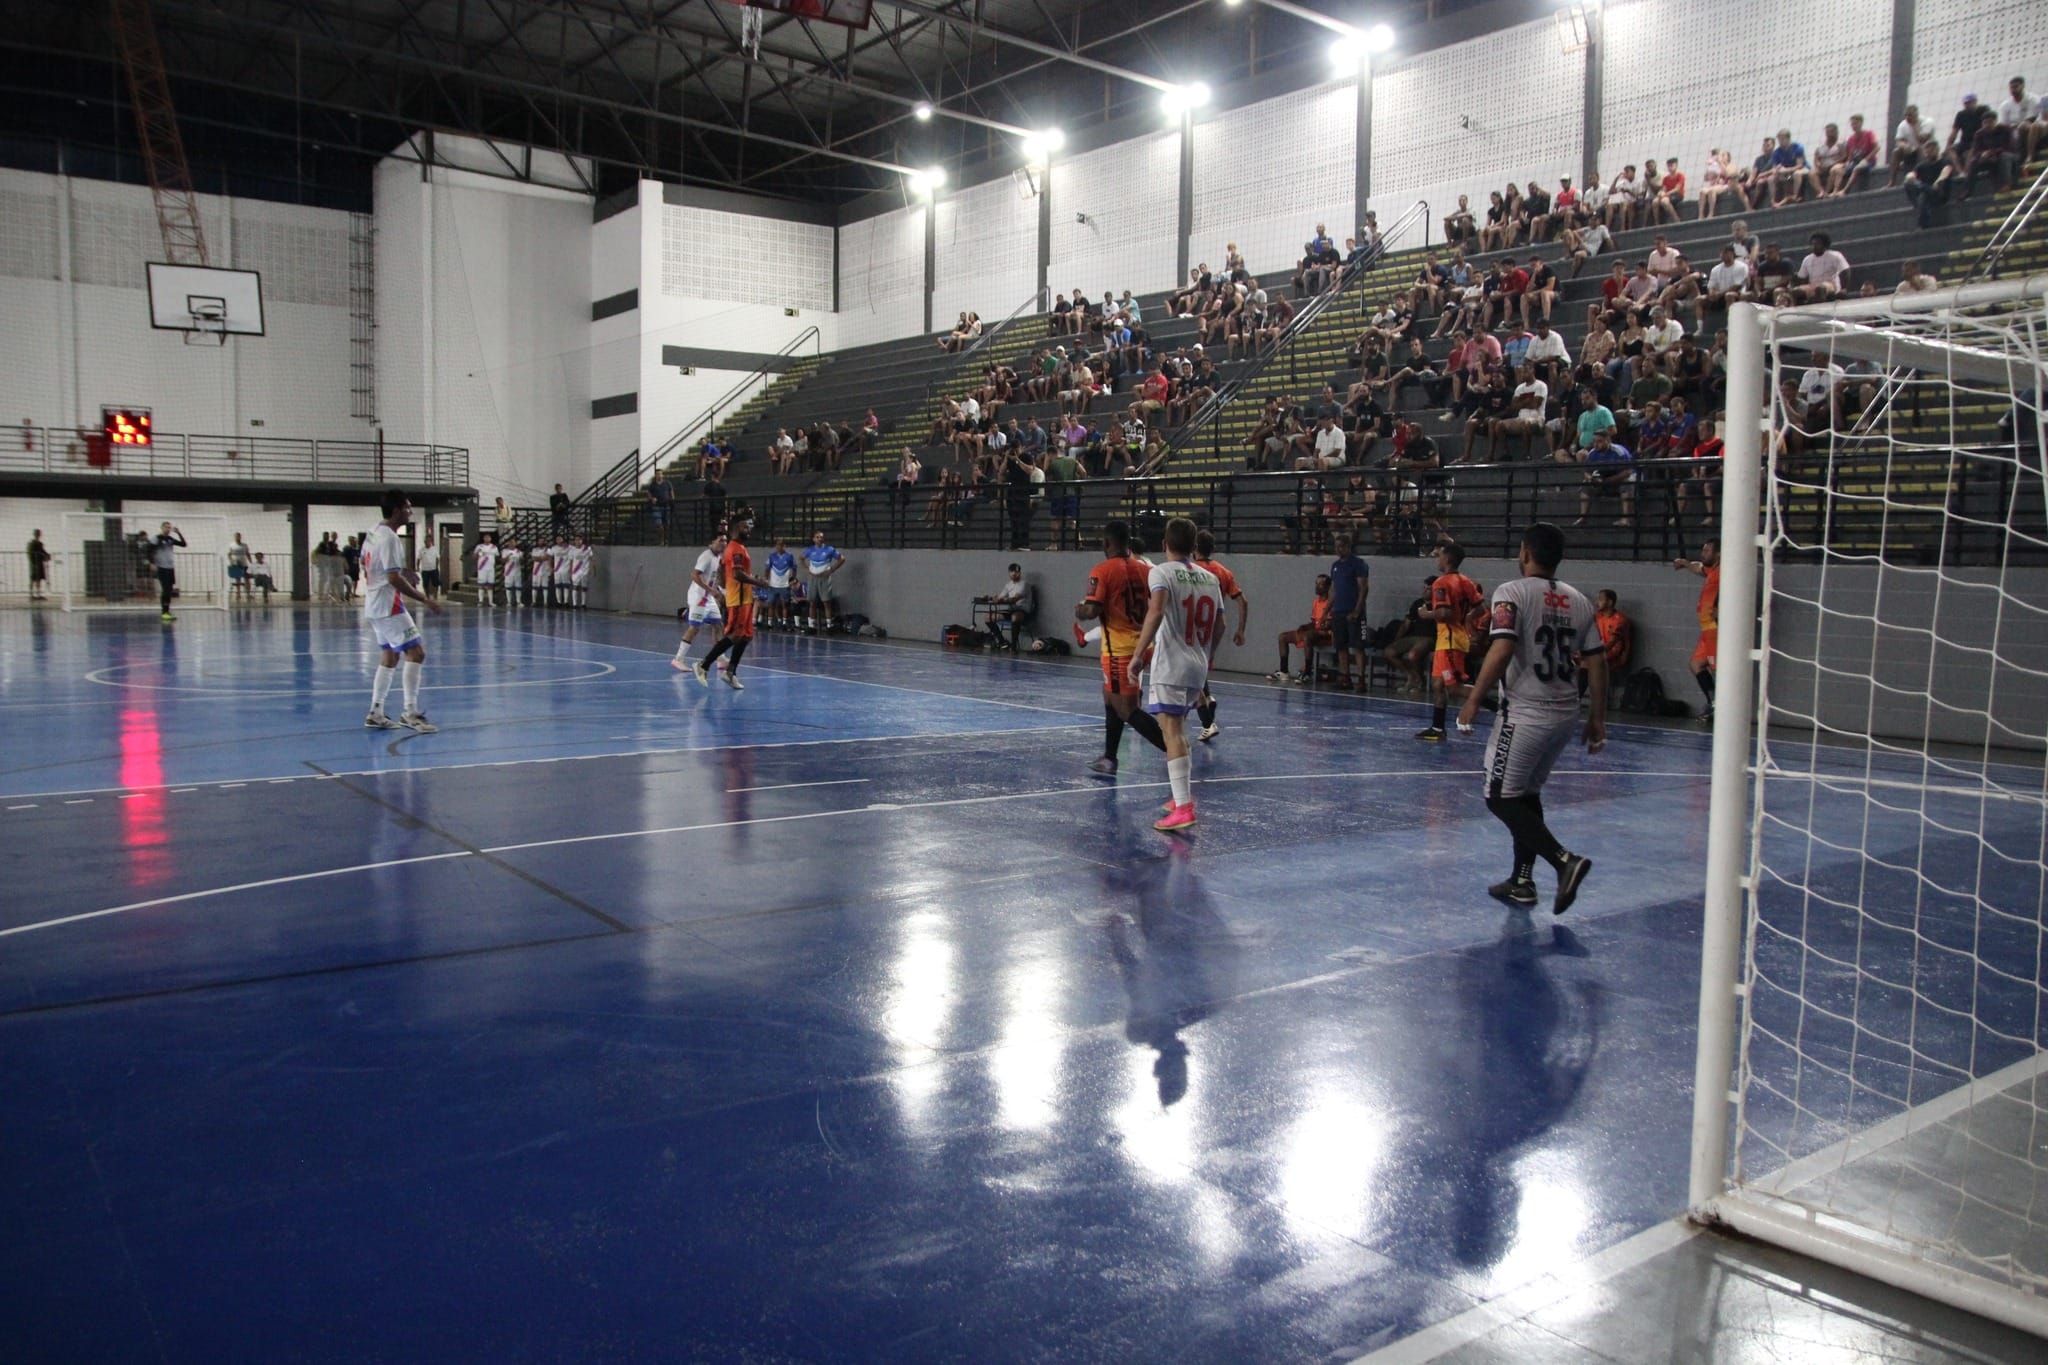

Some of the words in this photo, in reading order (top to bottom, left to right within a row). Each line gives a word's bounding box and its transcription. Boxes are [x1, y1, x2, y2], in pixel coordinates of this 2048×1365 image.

[1182, 594, 1214, 647] 19
[1543, 591, 1570, 609] abc
[1534, 625, 1577, 684] 35
[1491, 722, 1514, 780] IVERPOOL
